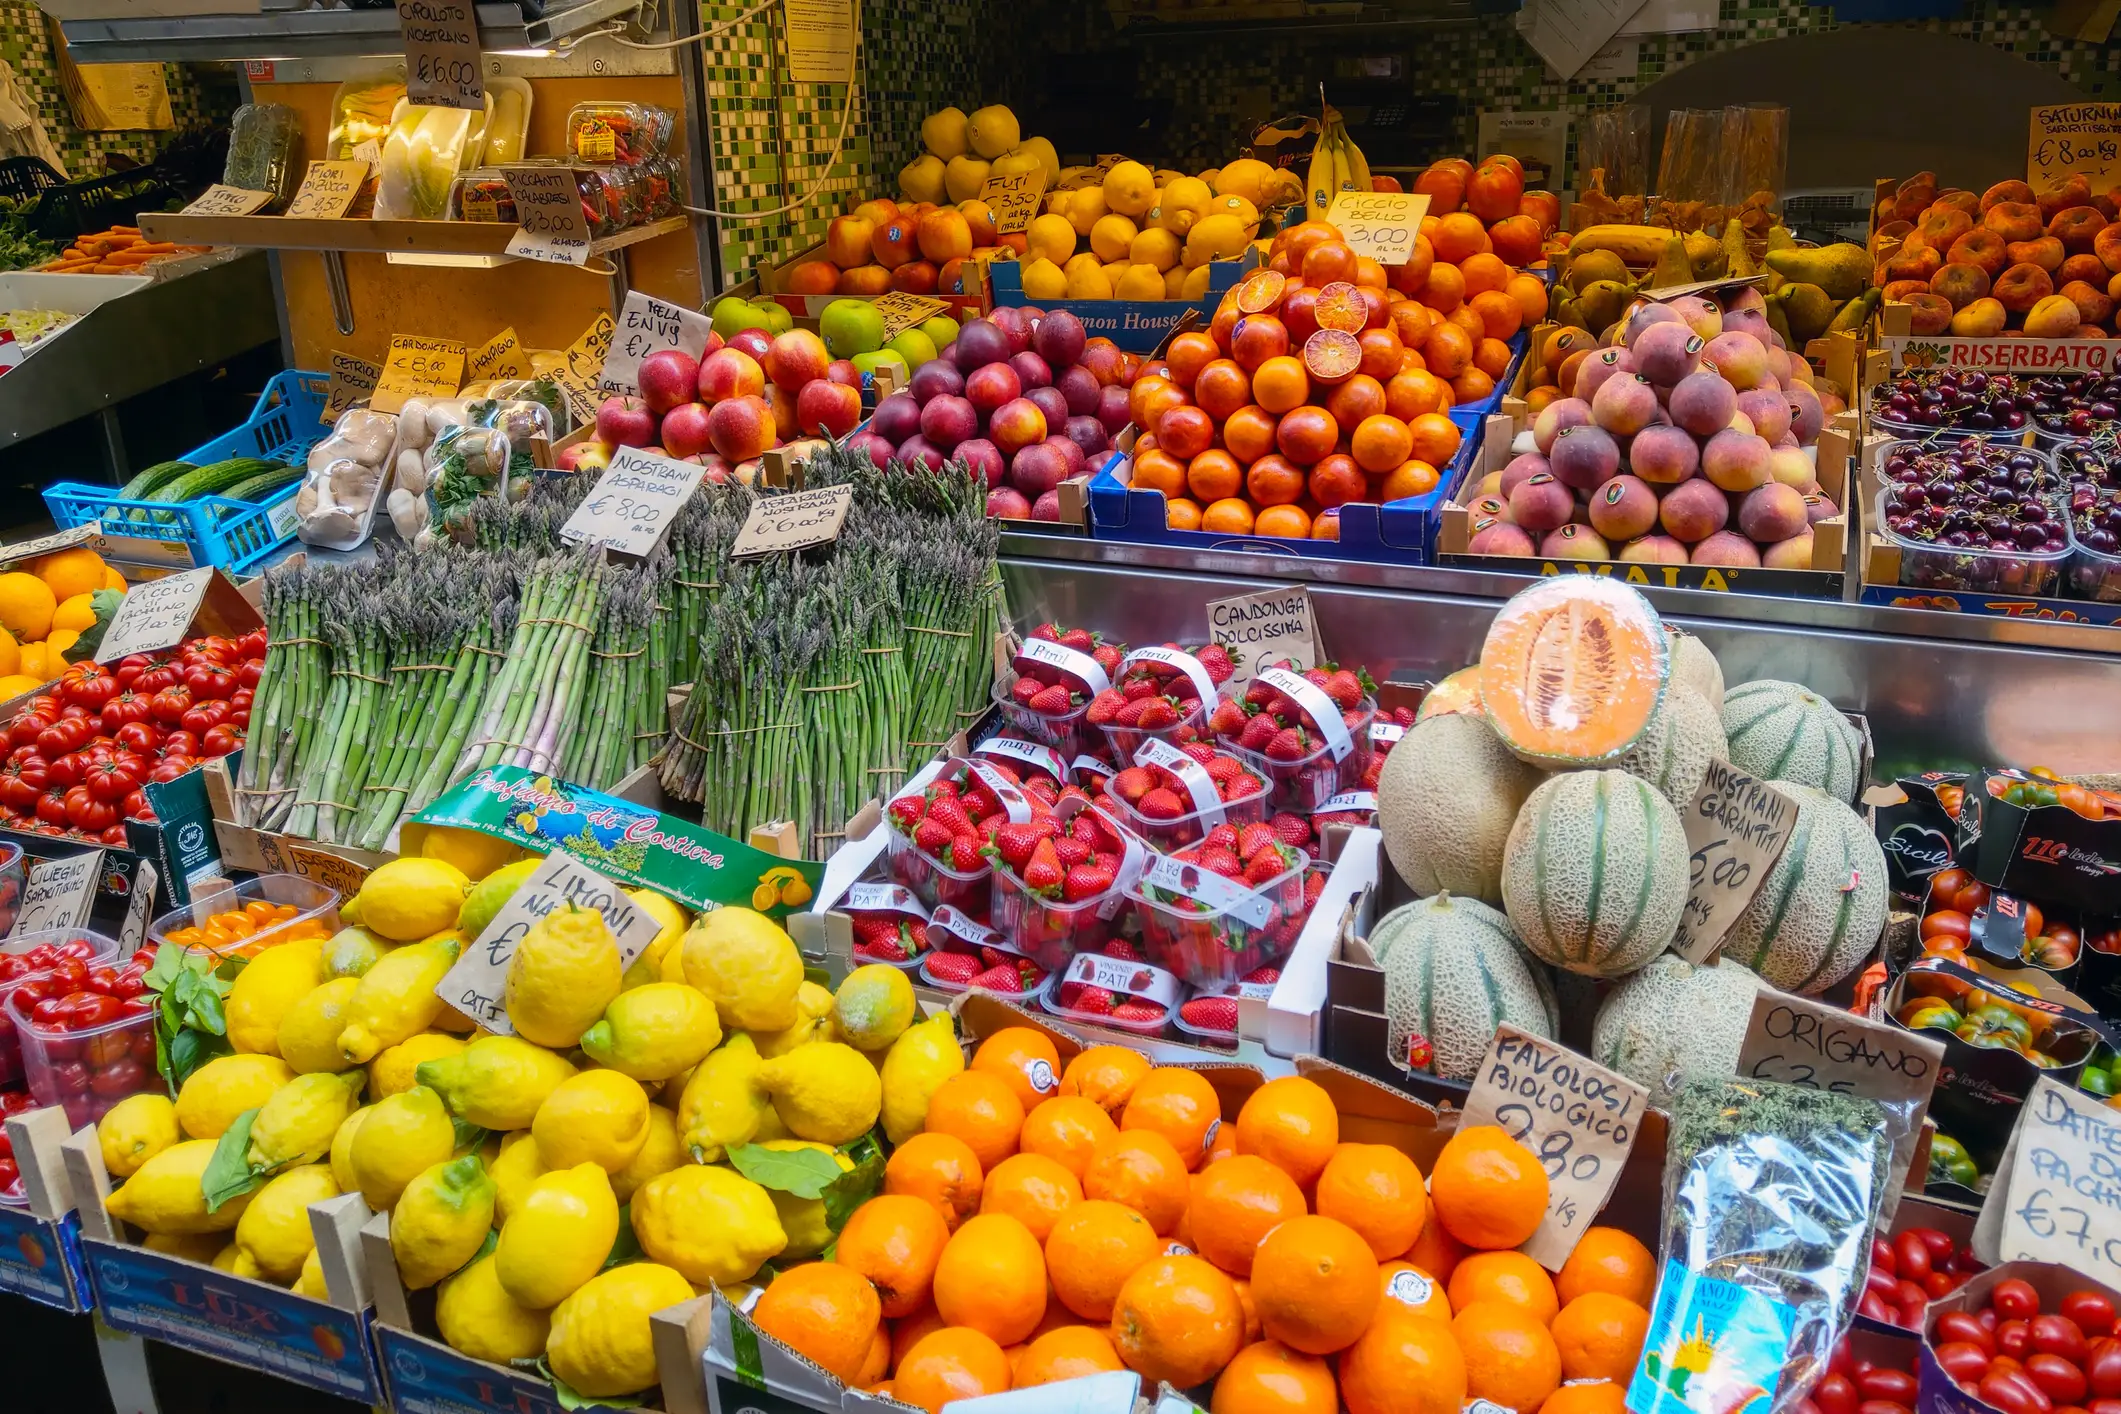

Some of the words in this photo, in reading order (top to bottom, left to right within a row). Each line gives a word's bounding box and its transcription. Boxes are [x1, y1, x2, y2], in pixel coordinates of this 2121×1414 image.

[399, 2, 465, 22] CIPOLLOTTO
[407, 27, 470, 44] NOSTRANO
[311, 163, 343, 179] FIORI
[506, 172, 563, 187] PICCANTI
[315, 180, 349, 192] ZUCCA
[515, 189, 571, 205] CALABRESI
[1349, 211, 1406, 221] BELLO
[648, 300, 682, 323] MELA
[1122, 312, 1179, 330] House
[393, 339, 466, 355] CARDONCELLO
[1951, 343, 2107, 368] RISERBATO
[603, 380, 623, 393] CAT
[613, 455, 691, 482] NOSTRANI
[607, 473, 681, 498] ASPARAGI
[755, 486, 851, 510] ASPARAGINA
[762, 497, 838, 518] NOSTRANA
[125, 583, 195, 607] RICCIO
[120, 602, 186, 622] PACHINO
[1214, 597, 1304, 626] CANDONGA
[1215, 619, 1303, 644] DOLCISSIMA
[1705, 762, 1785, 827] NOSTRANI
[463, 770, 576, 814] Profumo
[587, 807, 617, 829] di
[624, 817, 725, 870] Costiera
[1958, 809, 1982, 842] Sicily
[1882, 838, 1959, 870] Sicily
[544, 864, 634, 937] LIMONI
[852, 895, 882, 906] PATI
[952, 921, 981, 941] PATI
[1100, 962, 1133, 973] VINCENZO
[1097, 971, 1127, 988] PATI
[461, 990, 493, 1014] CAT
[1766, 1007, 1927, 1077] ORIGANO
[1489, 1063, 1628, 1144] BIOLOGICO
